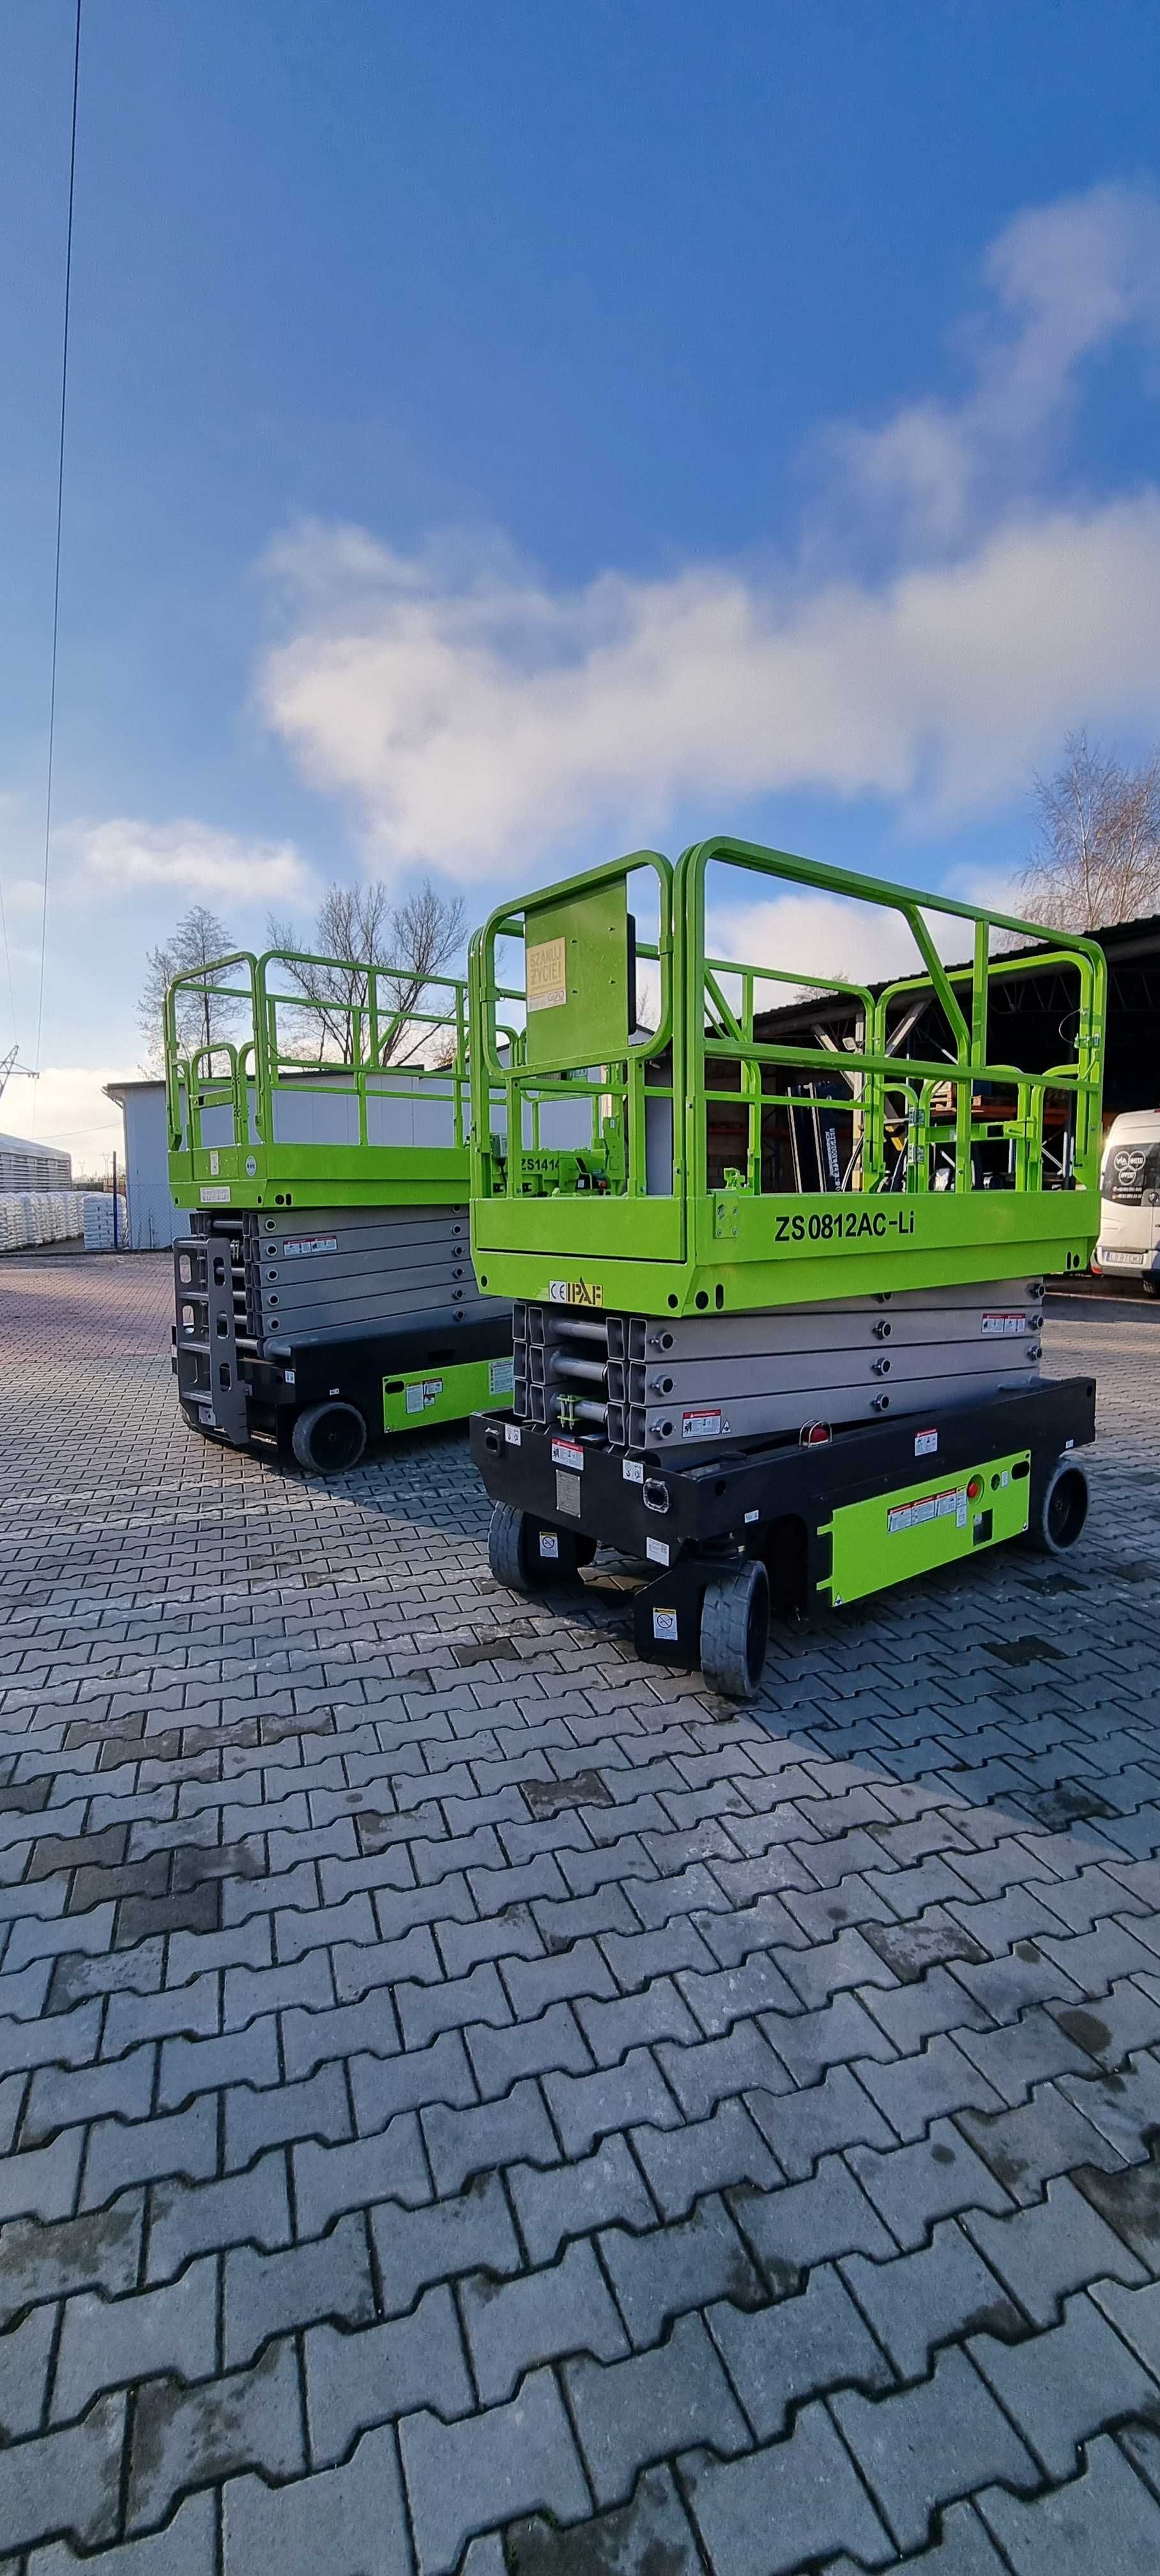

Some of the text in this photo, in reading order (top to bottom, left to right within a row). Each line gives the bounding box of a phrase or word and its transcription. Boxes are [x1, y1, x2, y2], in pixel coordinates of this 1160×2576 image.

[530, 946, 561, 967] SZANUJ
[775, 1210, 915, 1241] ZS0812AC-Li
[551, 1276, 601, 1305] CE IPAF
